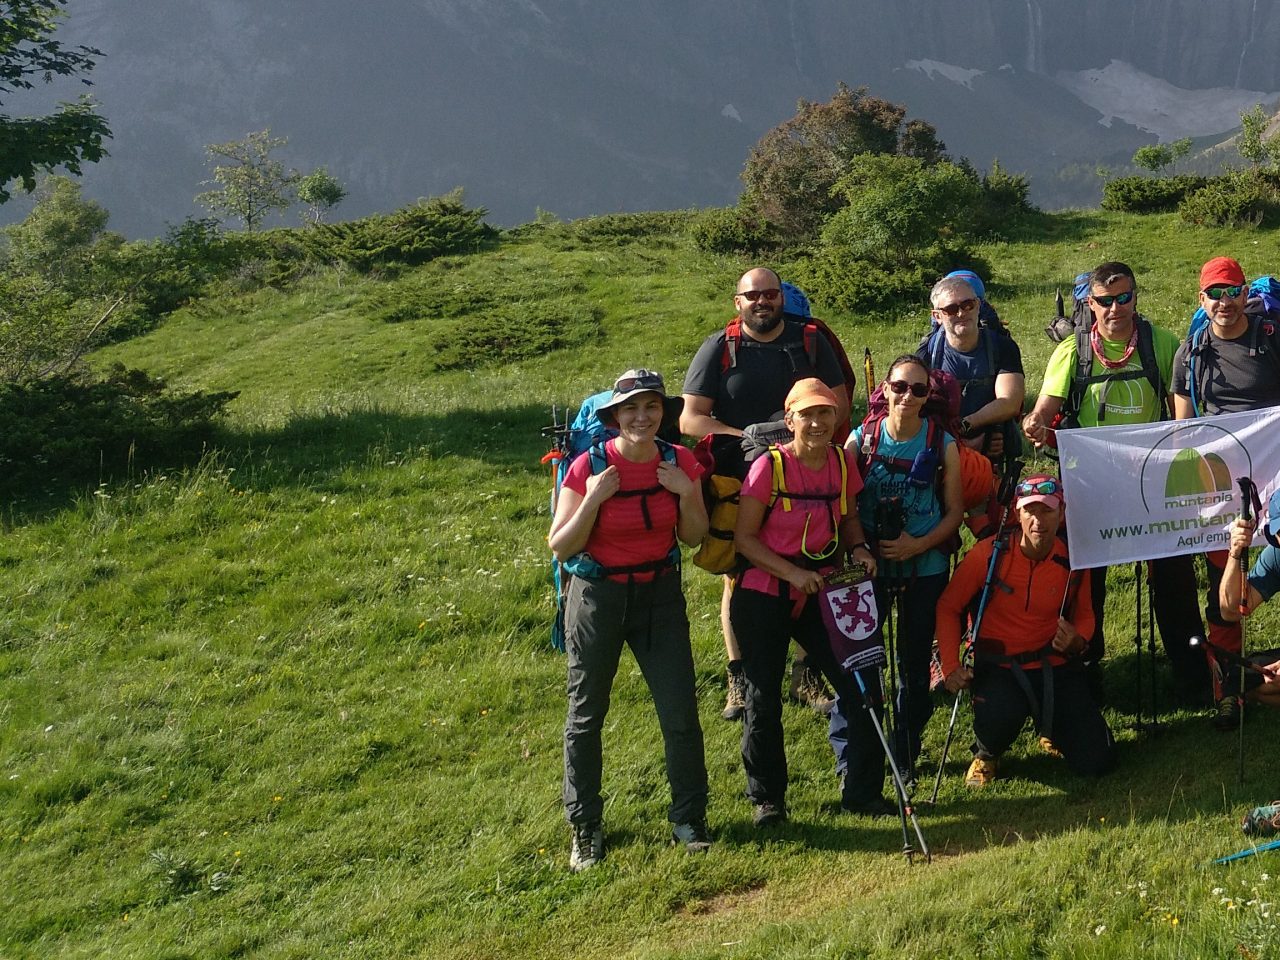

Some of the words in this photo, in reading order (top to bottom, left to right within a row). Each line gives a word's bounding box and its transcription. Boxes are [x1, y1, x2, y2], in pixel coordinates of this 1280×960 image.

[1165, 493, 1233, 509] muntania
[1099, 508, 1242, 540] www.muntani
[1206, 531, 1232, 543] emp
